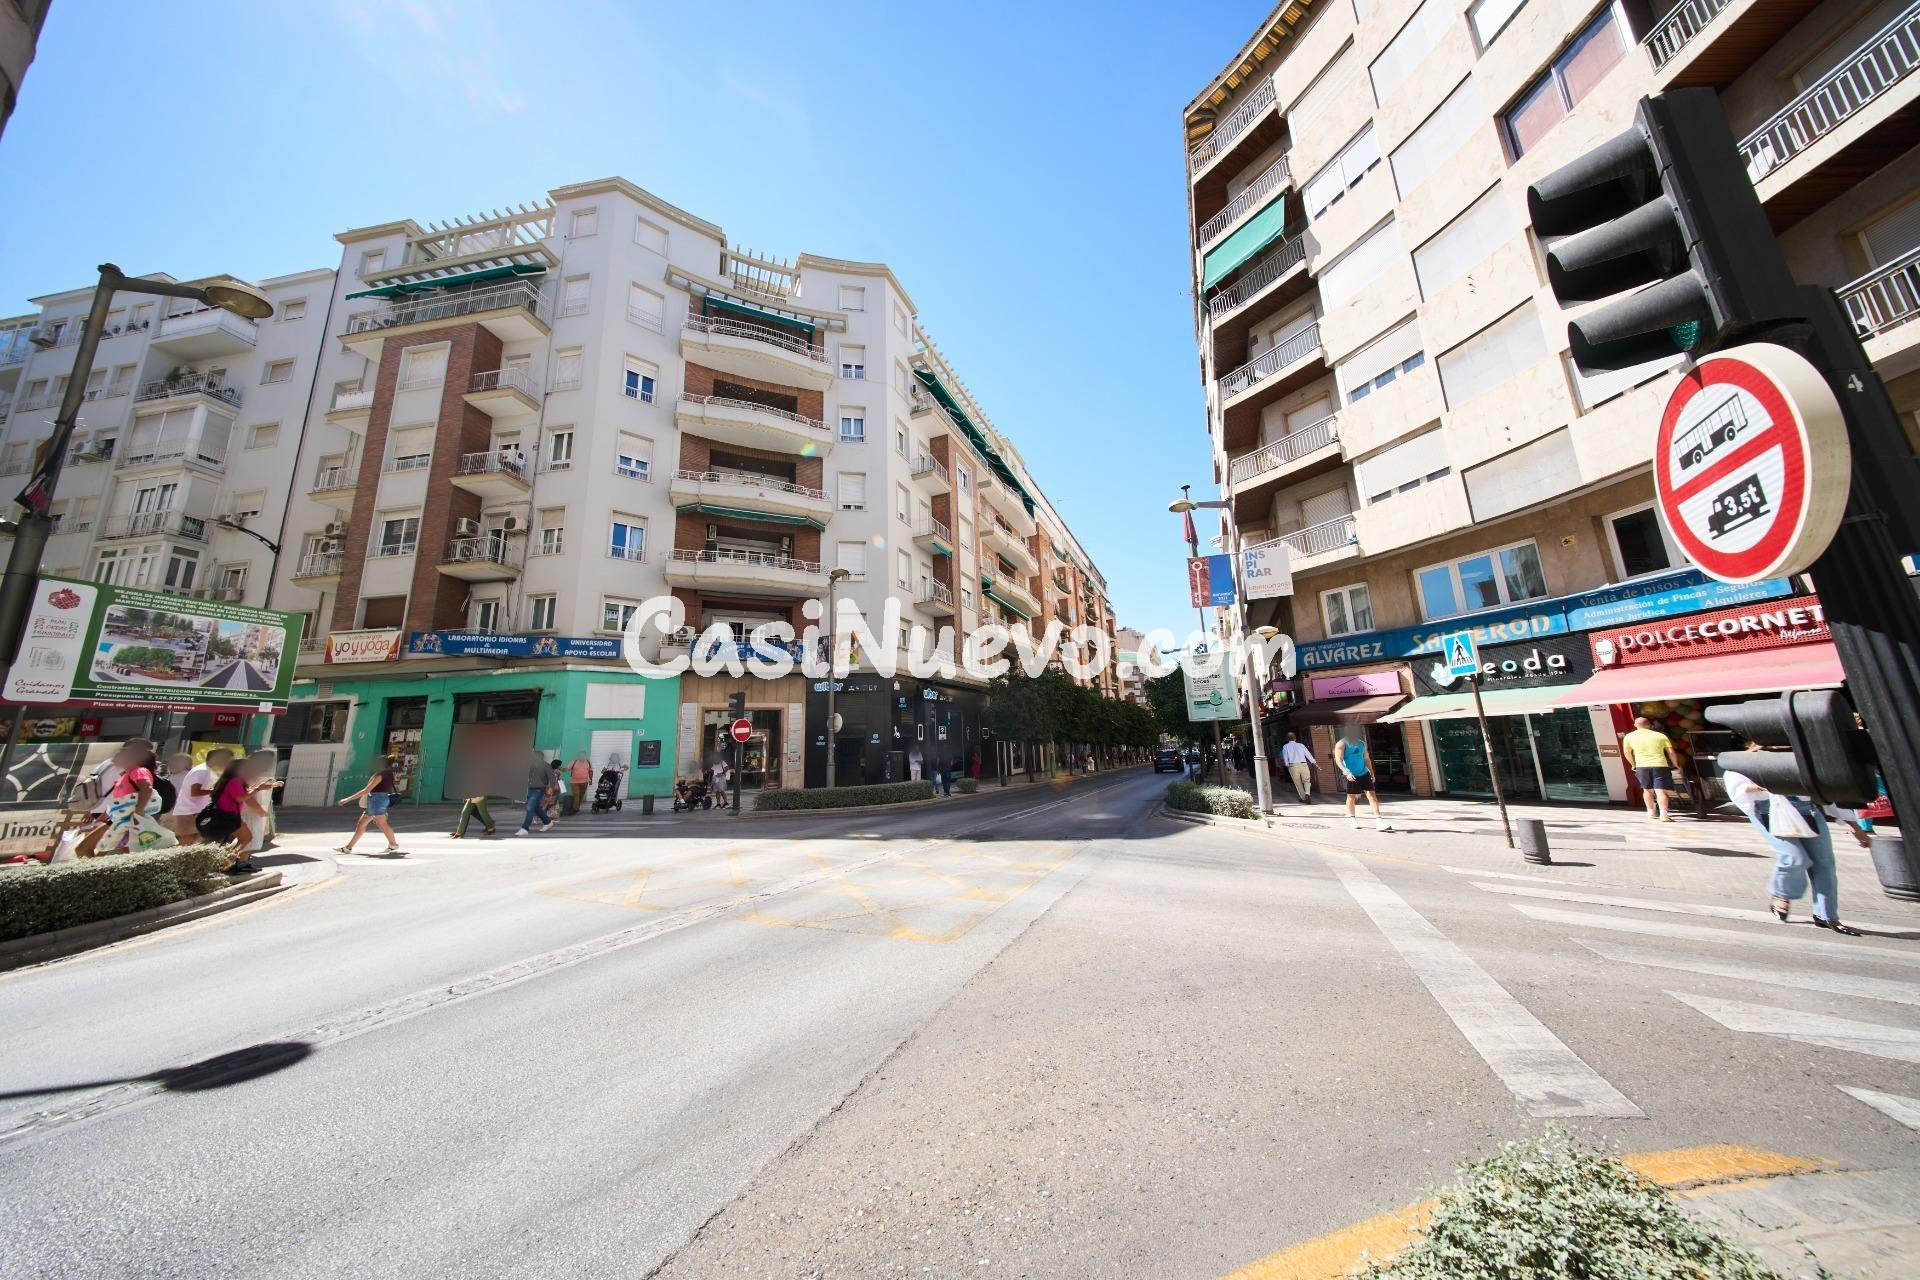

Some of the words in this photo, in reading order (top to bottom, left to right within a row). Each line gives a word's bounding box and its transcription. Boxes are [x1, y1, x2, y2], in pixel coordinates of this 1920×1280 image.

[1724, 483, 1760, 515] 3,5t
[1245, 551, 1266, 561] INS
[1246, 561, 1257, 570] PI
[1247, 568, 1273, 579] RAR
[1579, 594, 1617, 607] Venta
[1622, 589, 1638, 599] de
[1643, 581, 1681, 597] pisos
[1686, 578, 1695, 588] y
[1583, 600, 1654, 619] Administración
[1672, 590, 1707, 602] Fincas
[1628, 609, 1666, 623] Jurídica
[1705, 590, 1768, 607] Alquileres
[498, 636, 527, 644] IDIOMAS
[570, 639, 613, 647] UNIVERSIDAD
[1412, 614, 1551, 652] SAERON
[335, 642, 350, 656] yo
[360, 640, 390, 655] yoga
[463, 647, 509, 655] MULTIMEDIA
[1303, 642, 1384, 666] ALVAREZ
[1472, 649, 1566, 677] eoda
